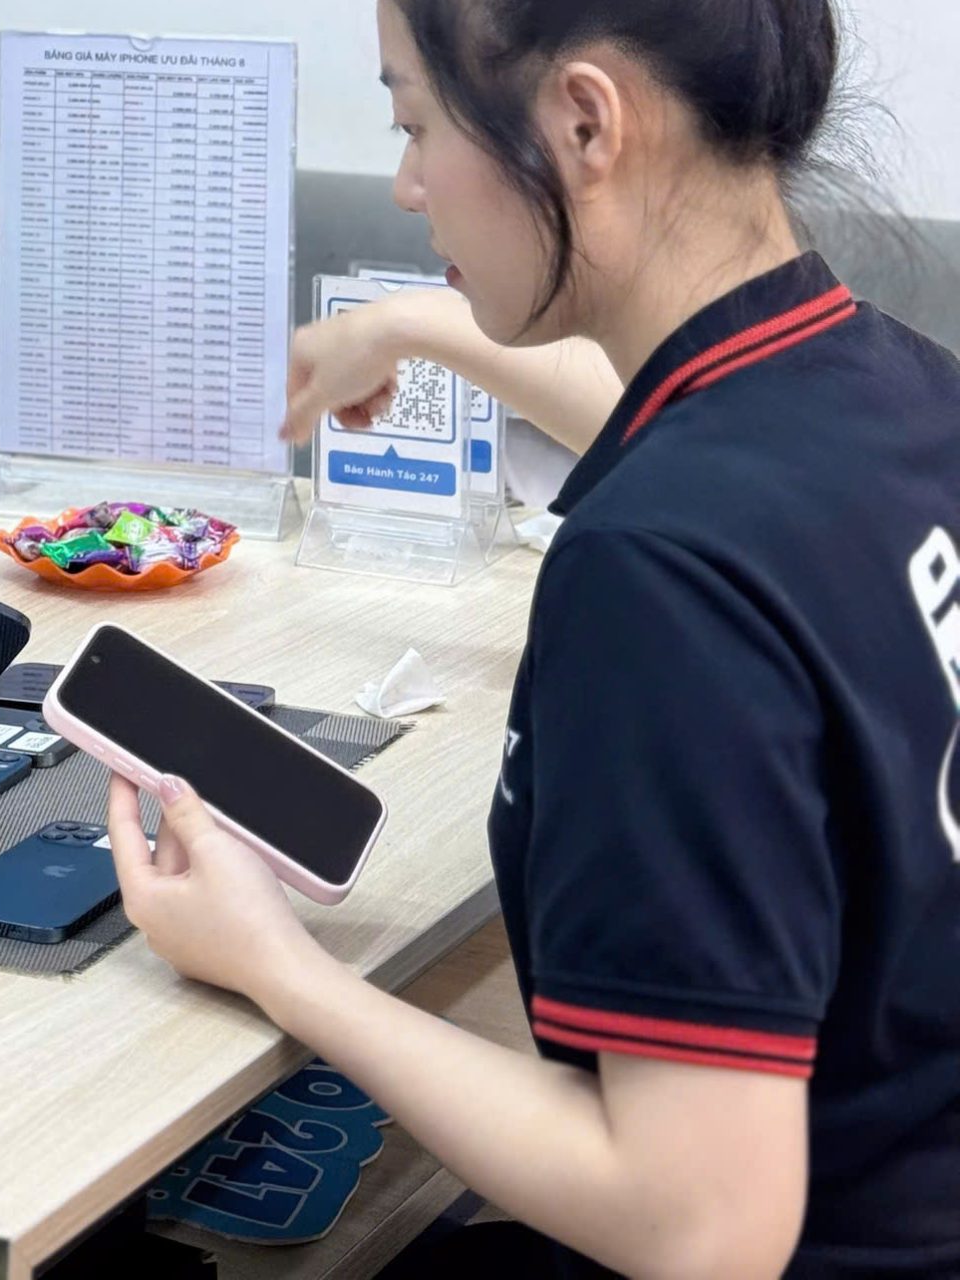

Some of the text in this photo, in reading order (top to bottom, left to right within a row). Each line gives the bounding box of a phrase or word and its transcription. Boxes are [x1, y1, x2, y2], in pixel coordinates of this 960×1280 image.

[120, 53, 158, 65] IPHONE
[419, 472, 440, 484] 247
[182, 1109, 348, 1229] 247
